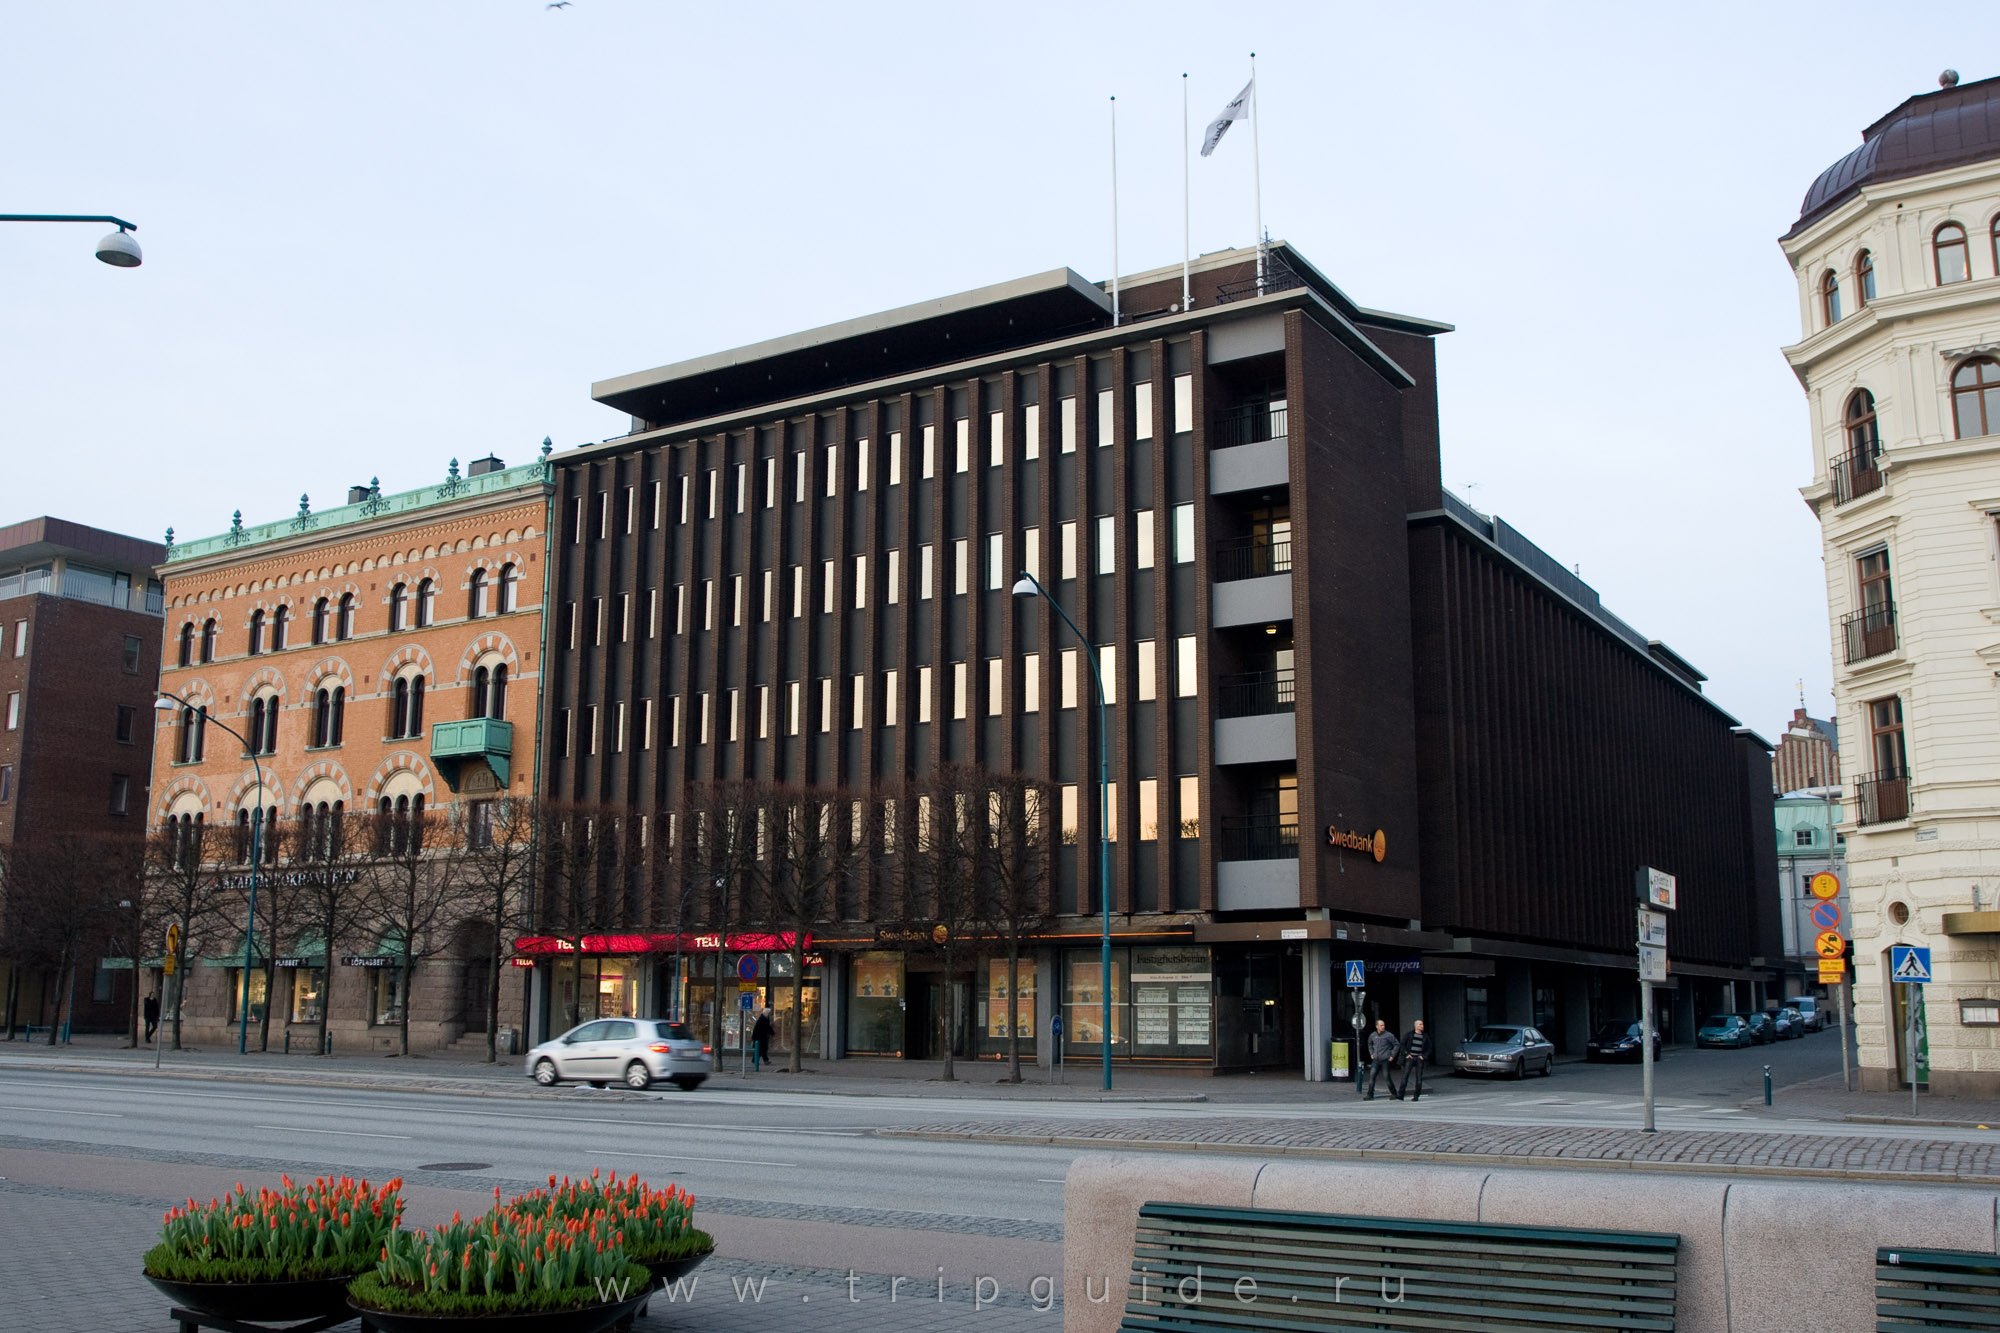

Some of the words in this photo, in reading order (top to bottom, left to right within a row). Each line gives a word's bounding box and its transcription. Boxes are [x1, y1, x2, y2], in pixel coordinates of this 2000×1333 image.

[1329, 825, 1373, 853] Swedbank
[880, 929, 928, 941] Swedban
[556, 939, 587, 950] TEL
[695, 936, 729, 948] TELI
[515, 959, 534, 967] TELIA
